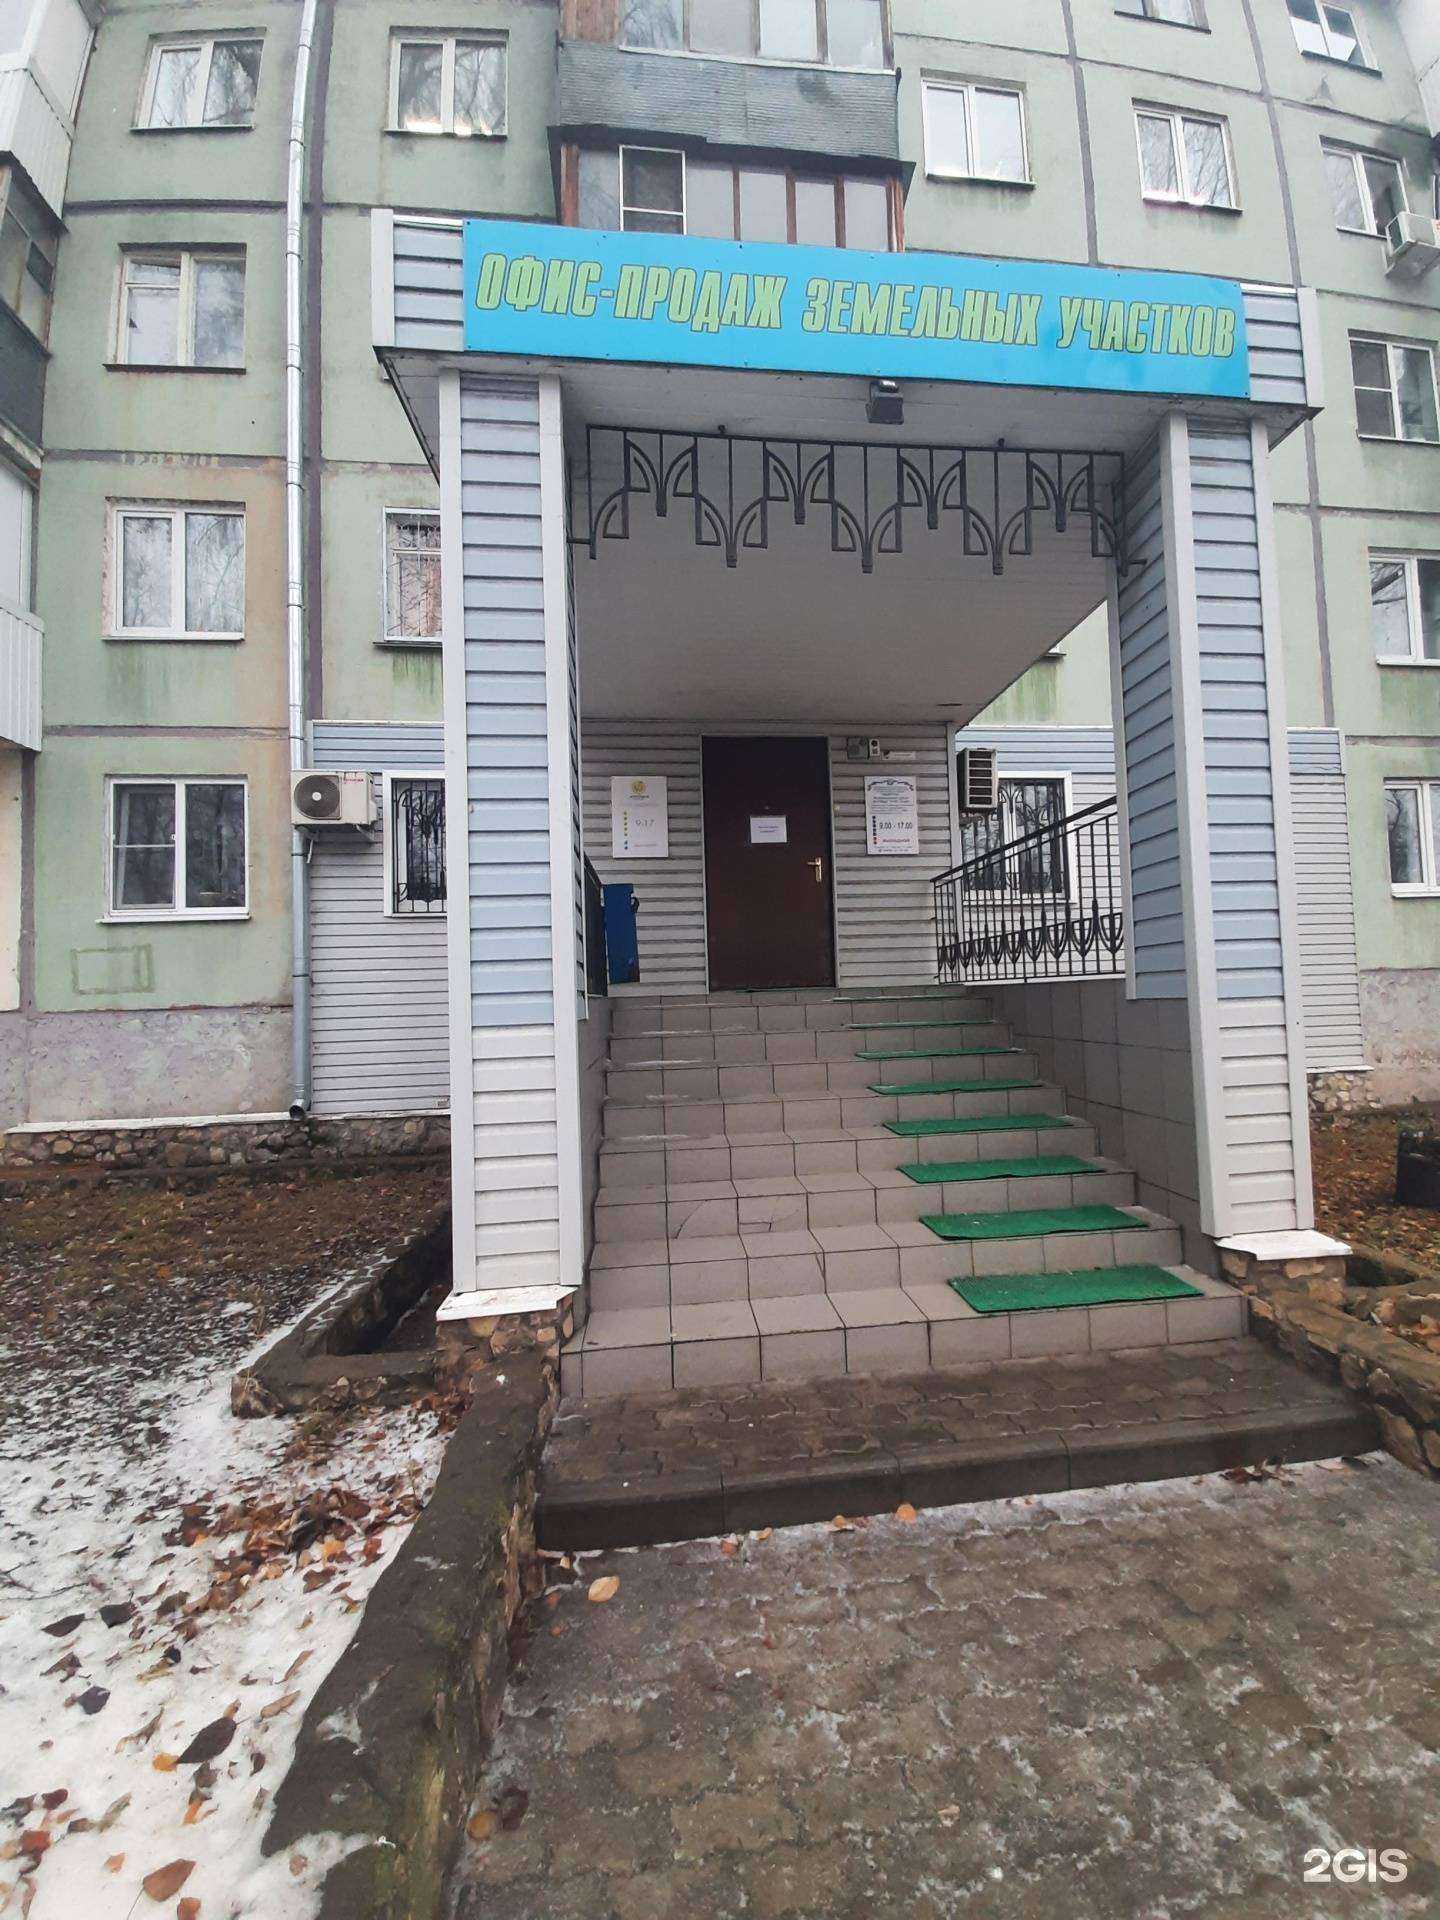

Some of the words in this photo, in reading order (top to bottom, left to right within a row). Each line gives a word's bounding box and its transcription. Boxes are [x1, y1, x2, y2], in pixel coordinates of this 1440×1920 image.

[476, 253, 787, 333] ОФИС-ПРОДАЖ
[802, 277, 1042, 346] ЗЕМЕЛЬНЫХ
[1056, 295, 1237, 358] УЧАСТКОВ
